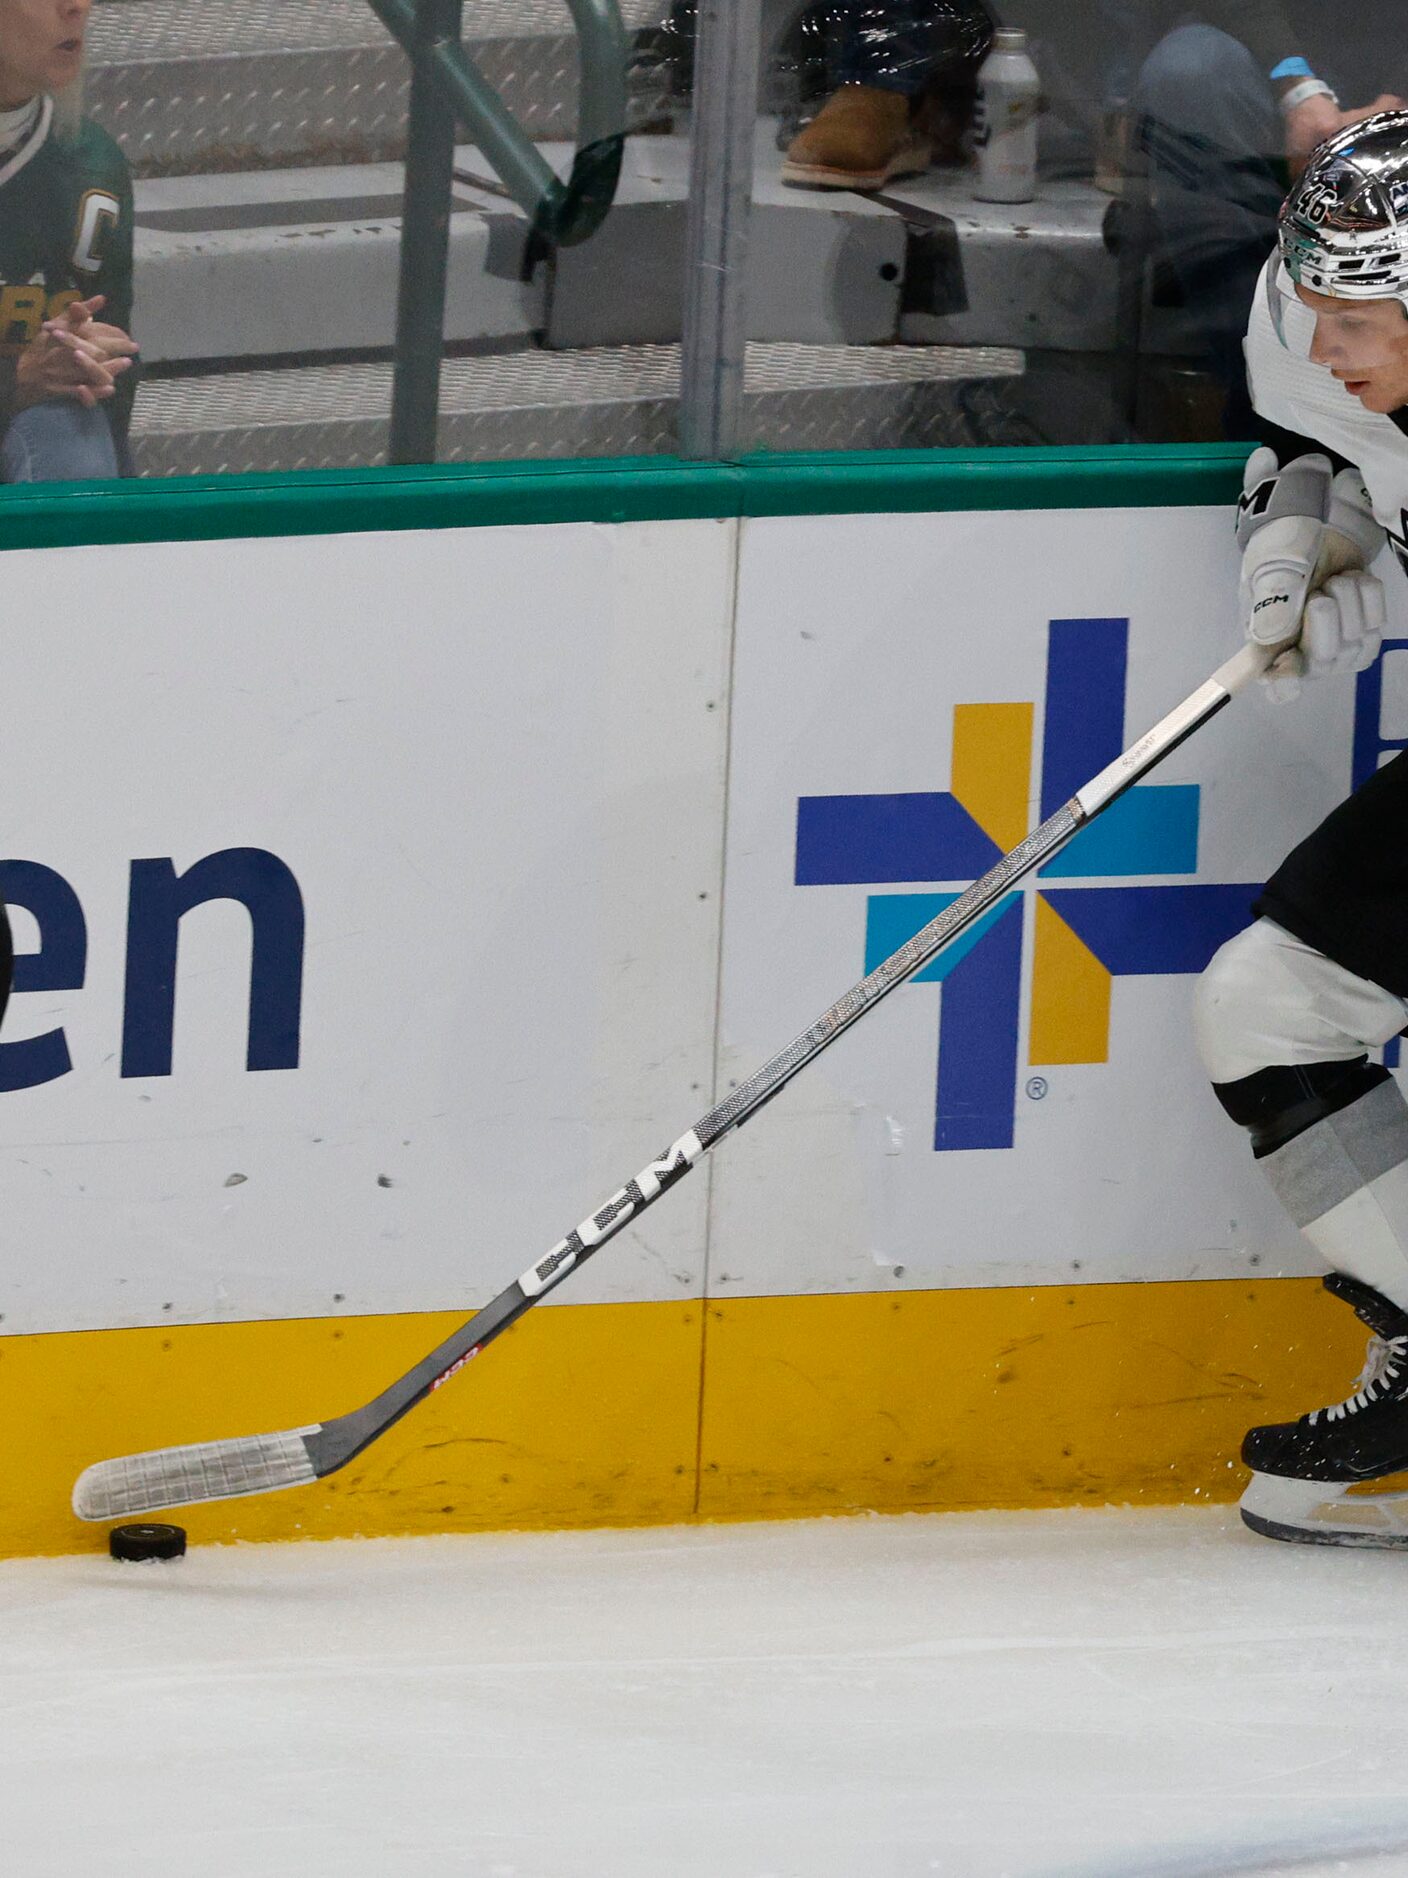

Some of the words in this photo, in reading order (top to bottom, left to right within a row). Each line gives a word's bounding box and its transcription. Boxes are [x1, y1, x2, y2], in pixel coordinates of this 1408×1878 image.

[72, 189, 120, 273] C
[1297, 183, 1338, 225] 46
[1254, 595, 1309, 614] CCM
[517, 1128, 703, 1297] CCM
